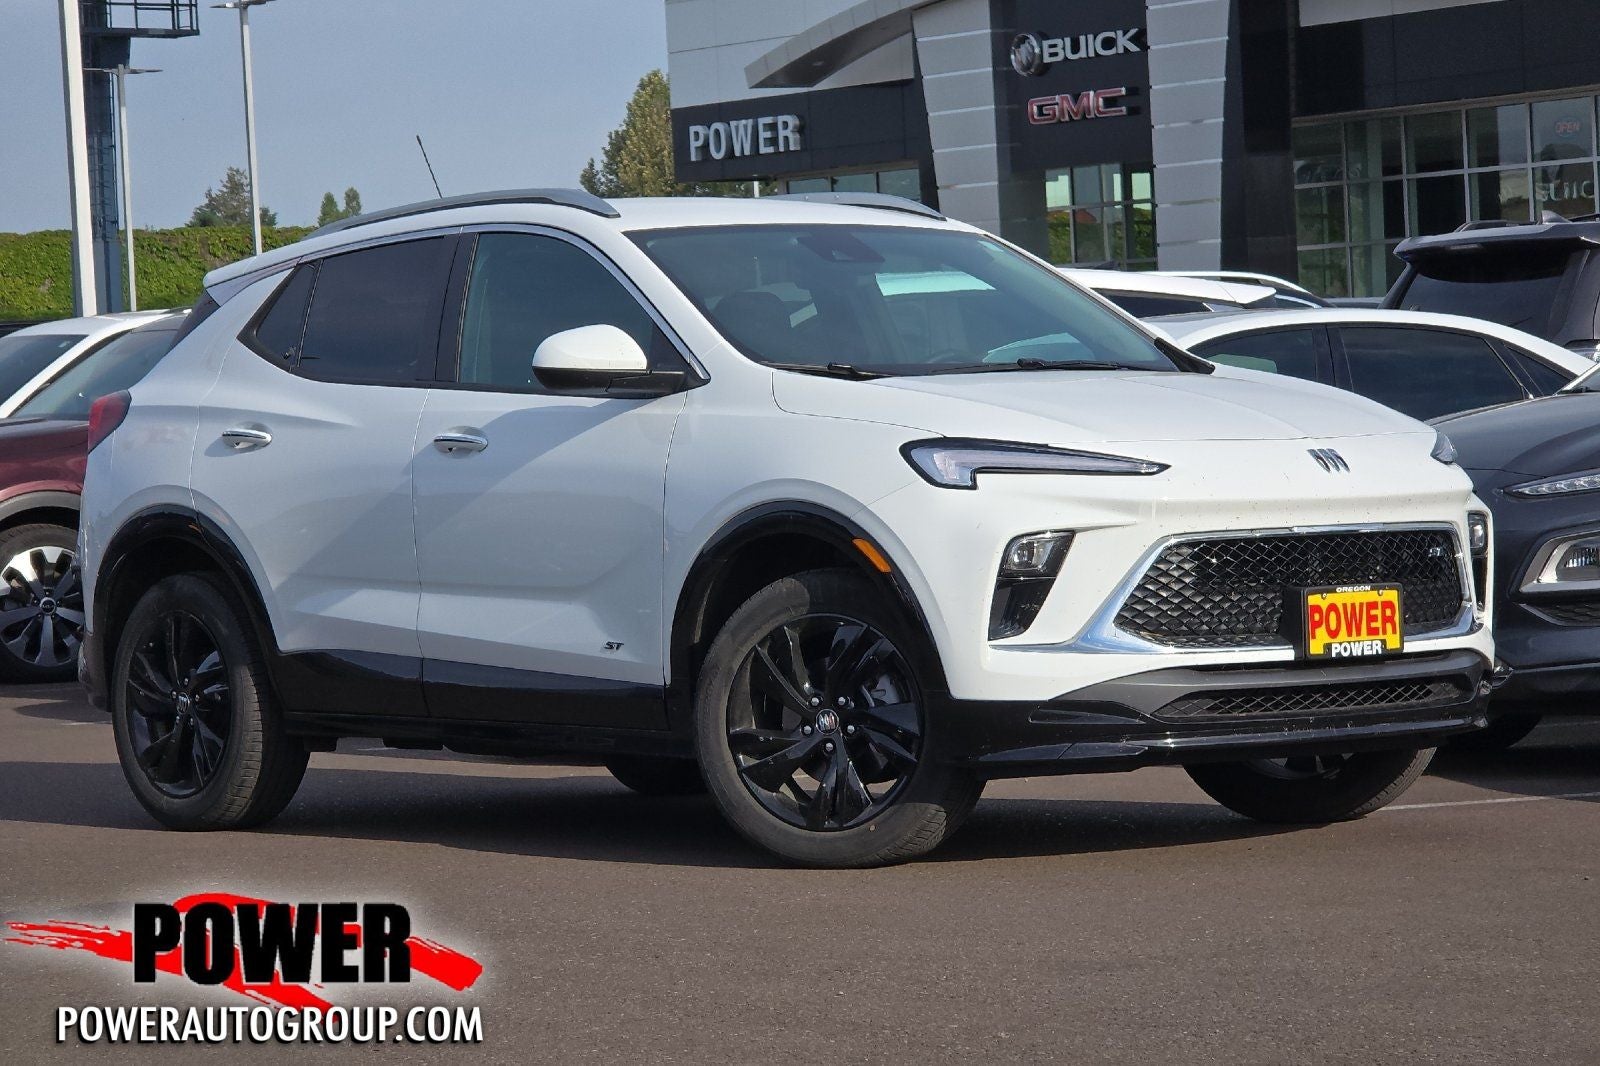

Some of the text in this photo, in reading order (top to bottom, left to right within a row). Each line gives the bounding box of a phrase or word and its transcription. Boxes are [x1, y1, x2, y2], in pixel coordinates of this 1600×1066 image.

[1042, 28, 1140, 63] BUICK
[1028, 86, 1126, 124] GMC
[688, 114, 801, 161] POWER
[1336, 585, 1371, 593] OREGON
[1309, 600, 1397, 640] POWER
[604, 641, 624, 651] ST
[1331, 640, 1382, 658] POWER
